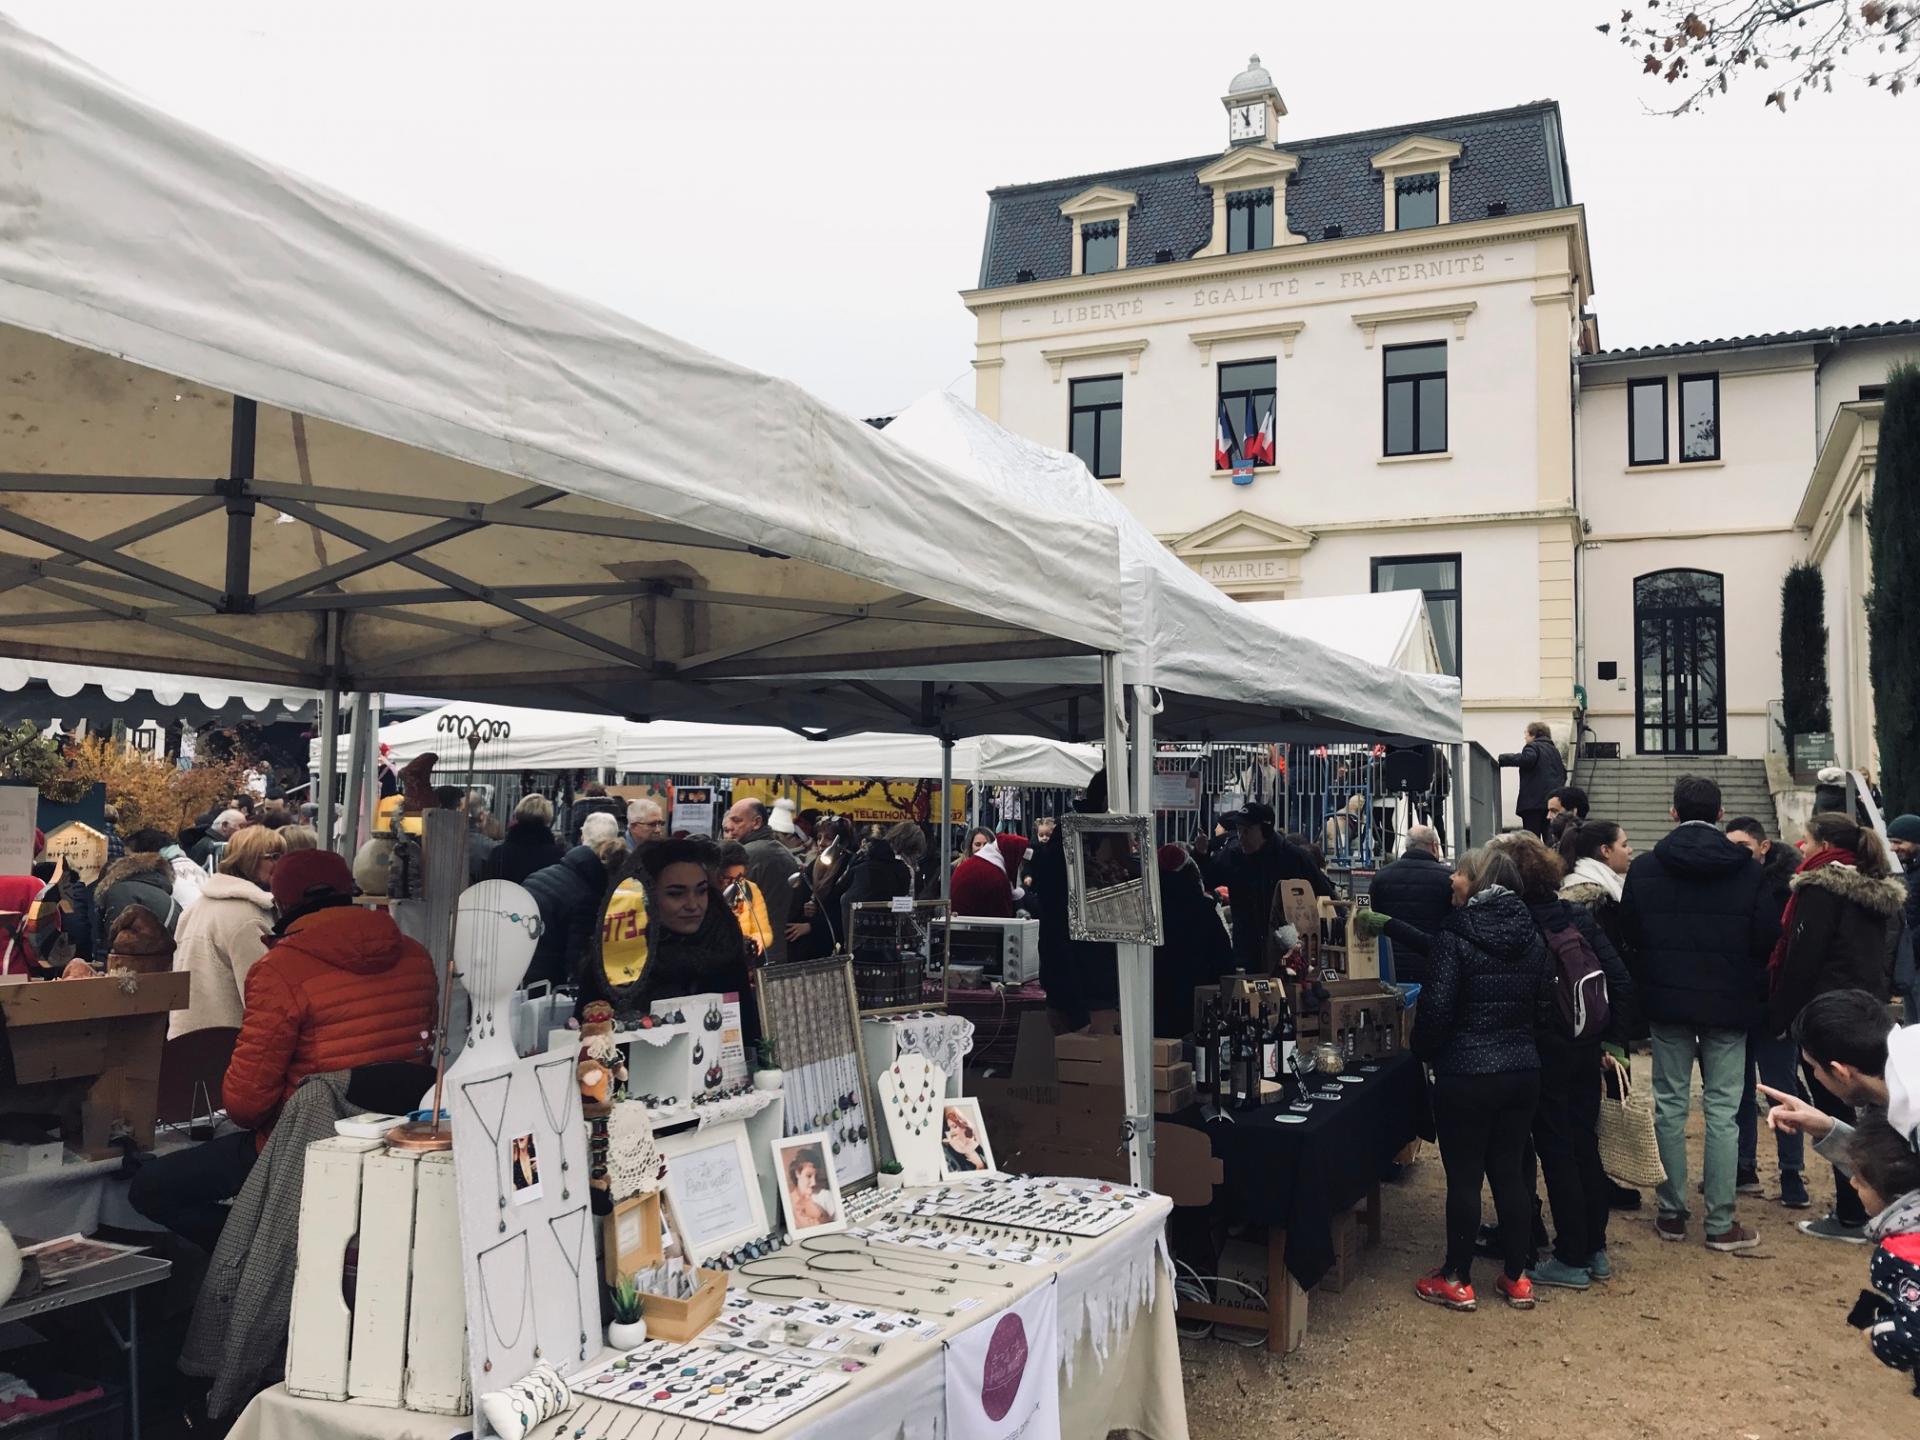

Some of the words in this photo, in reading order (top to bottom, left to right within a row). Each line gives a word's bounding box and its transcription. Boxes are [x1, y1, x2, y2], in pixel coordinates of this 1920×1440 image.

[1051, 296, 1144, 325] LIBERTÉ
[1192, 277, 1300, 307] ÉGALITÉ
[1339, 253, 1485, 290] FRATERNITÉ
[1211, 561, 1275, 578] MAIRIE
